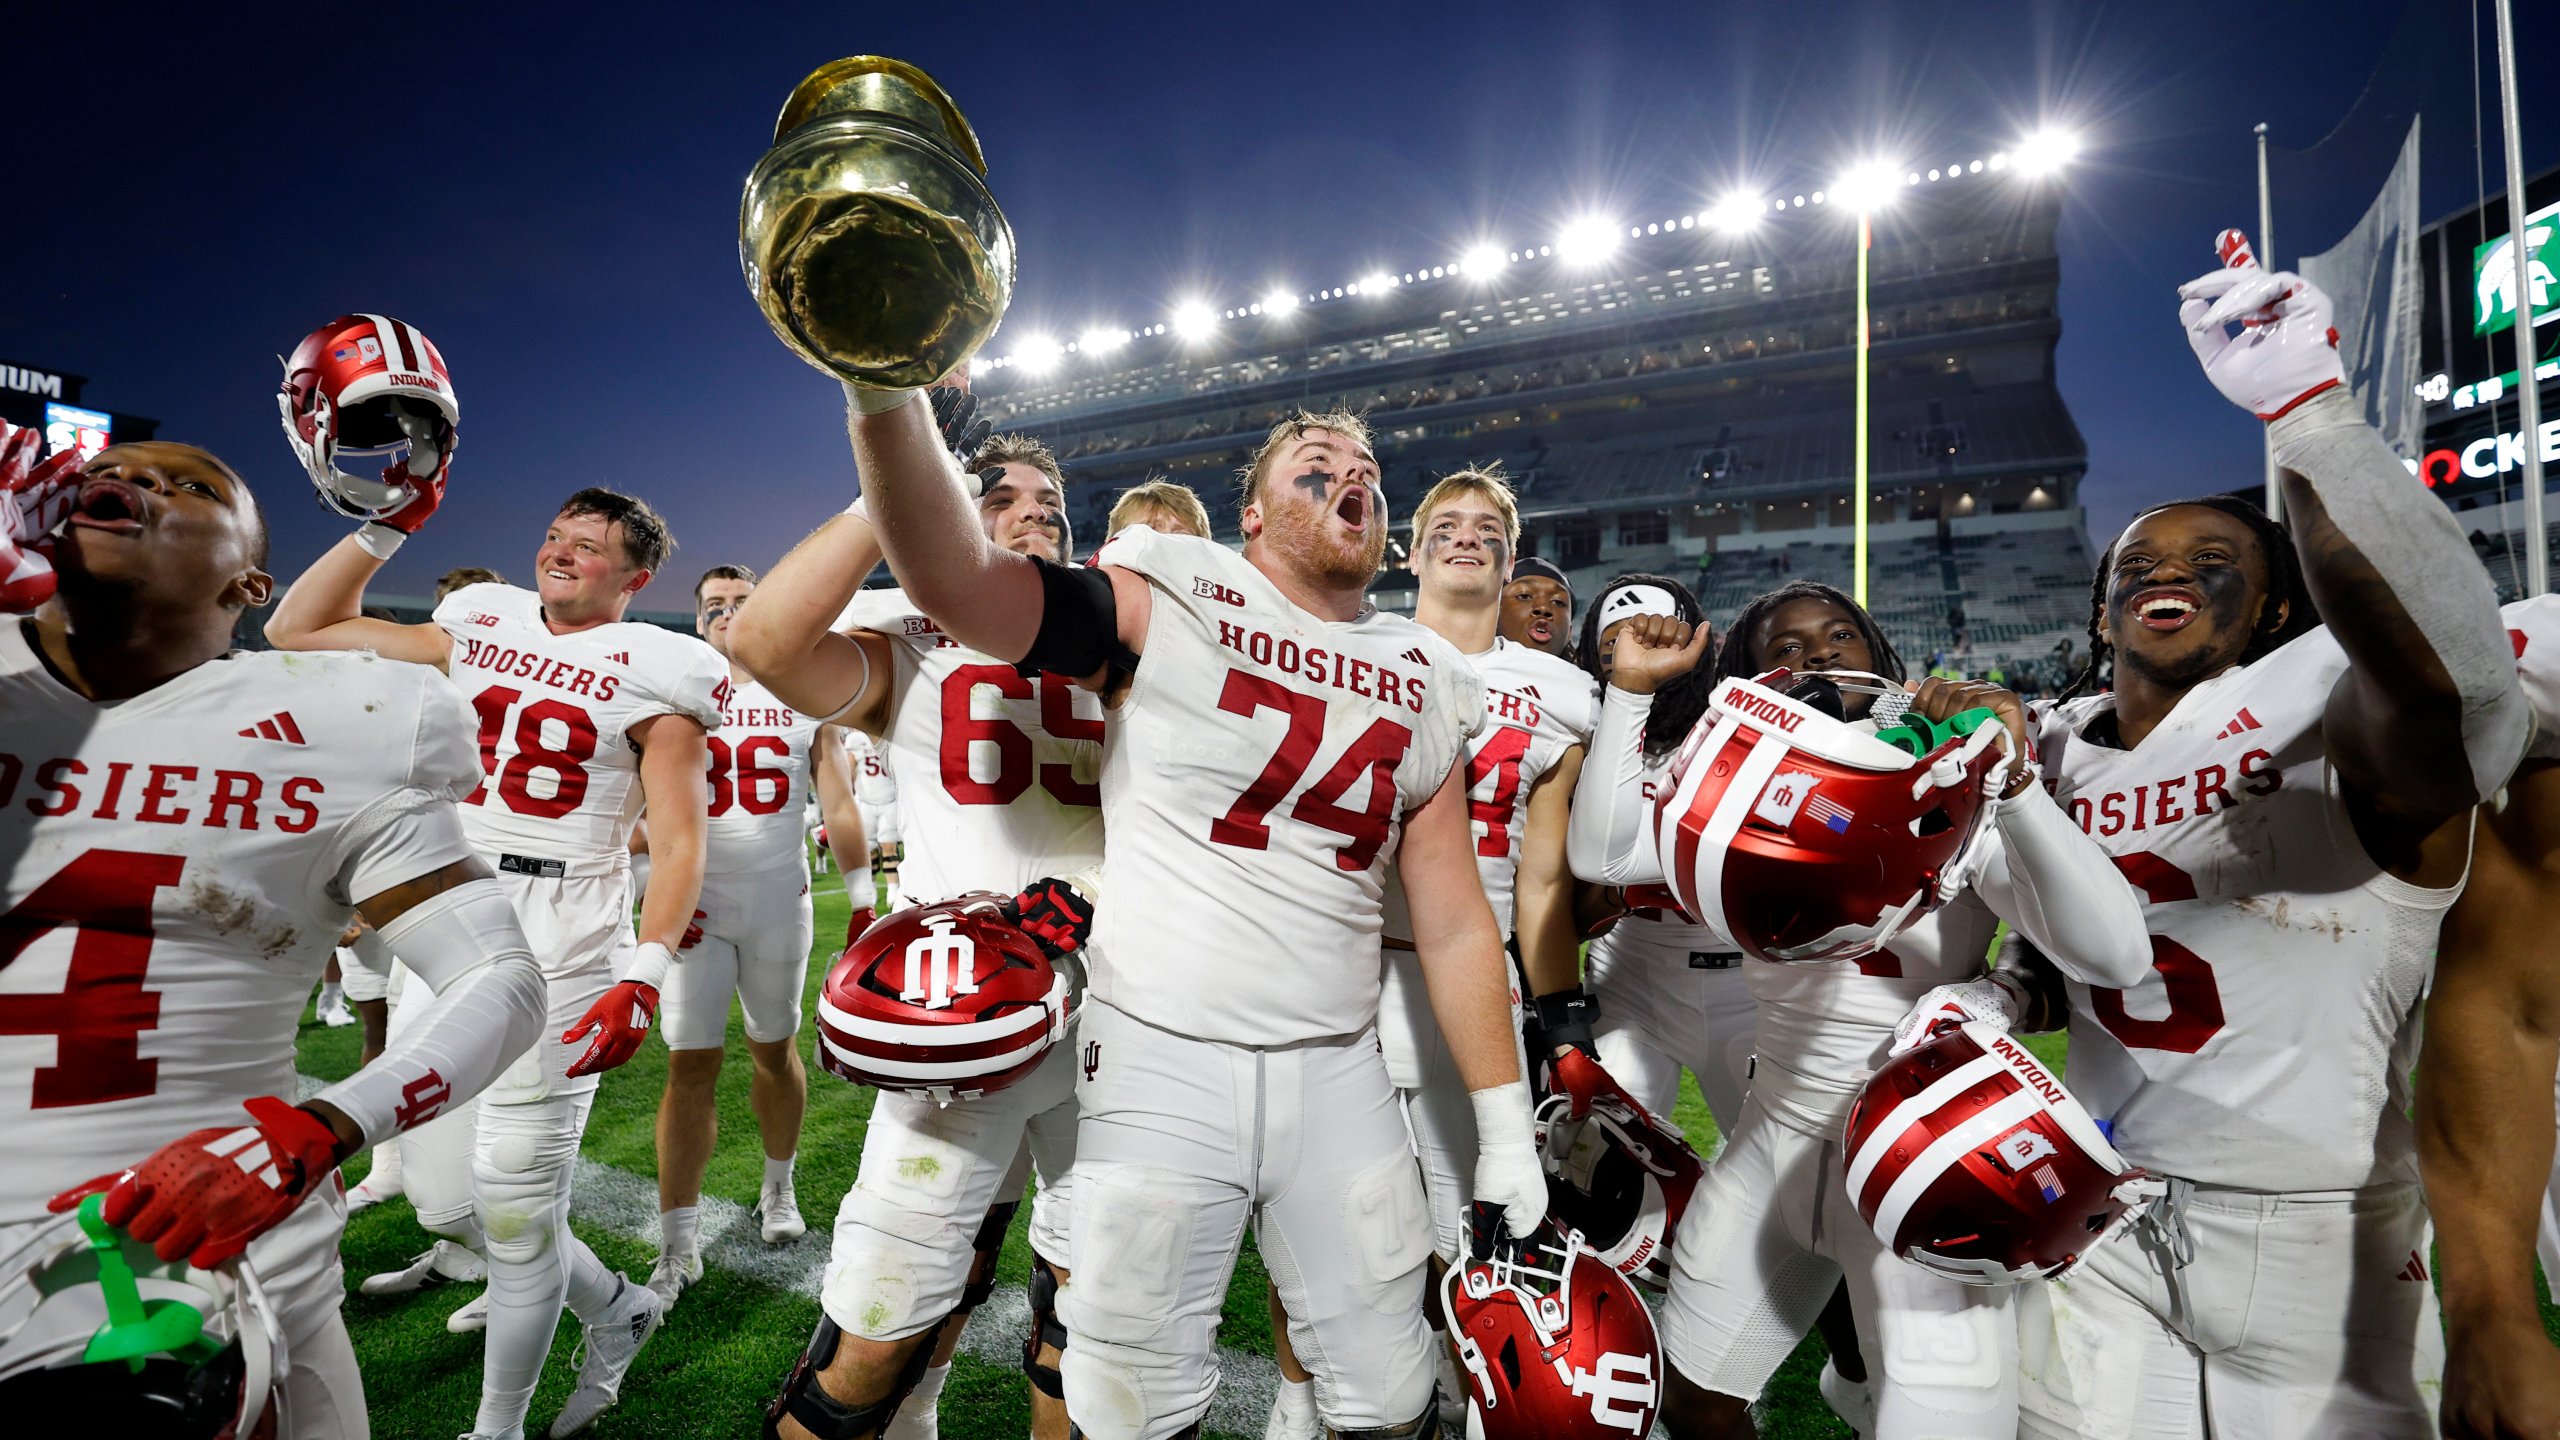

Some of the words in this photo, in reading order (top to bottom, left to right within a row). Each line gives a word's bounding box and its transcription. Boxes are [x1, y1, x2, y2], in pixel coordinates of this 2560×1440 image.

[461, 638, 620, 702] HOOSIERS
[1219, 619, 1426, 714] HOOSIERS
[1209, 667, 1413, 872] 74
[1991, 1037, 2066, 1106] INDIANA
